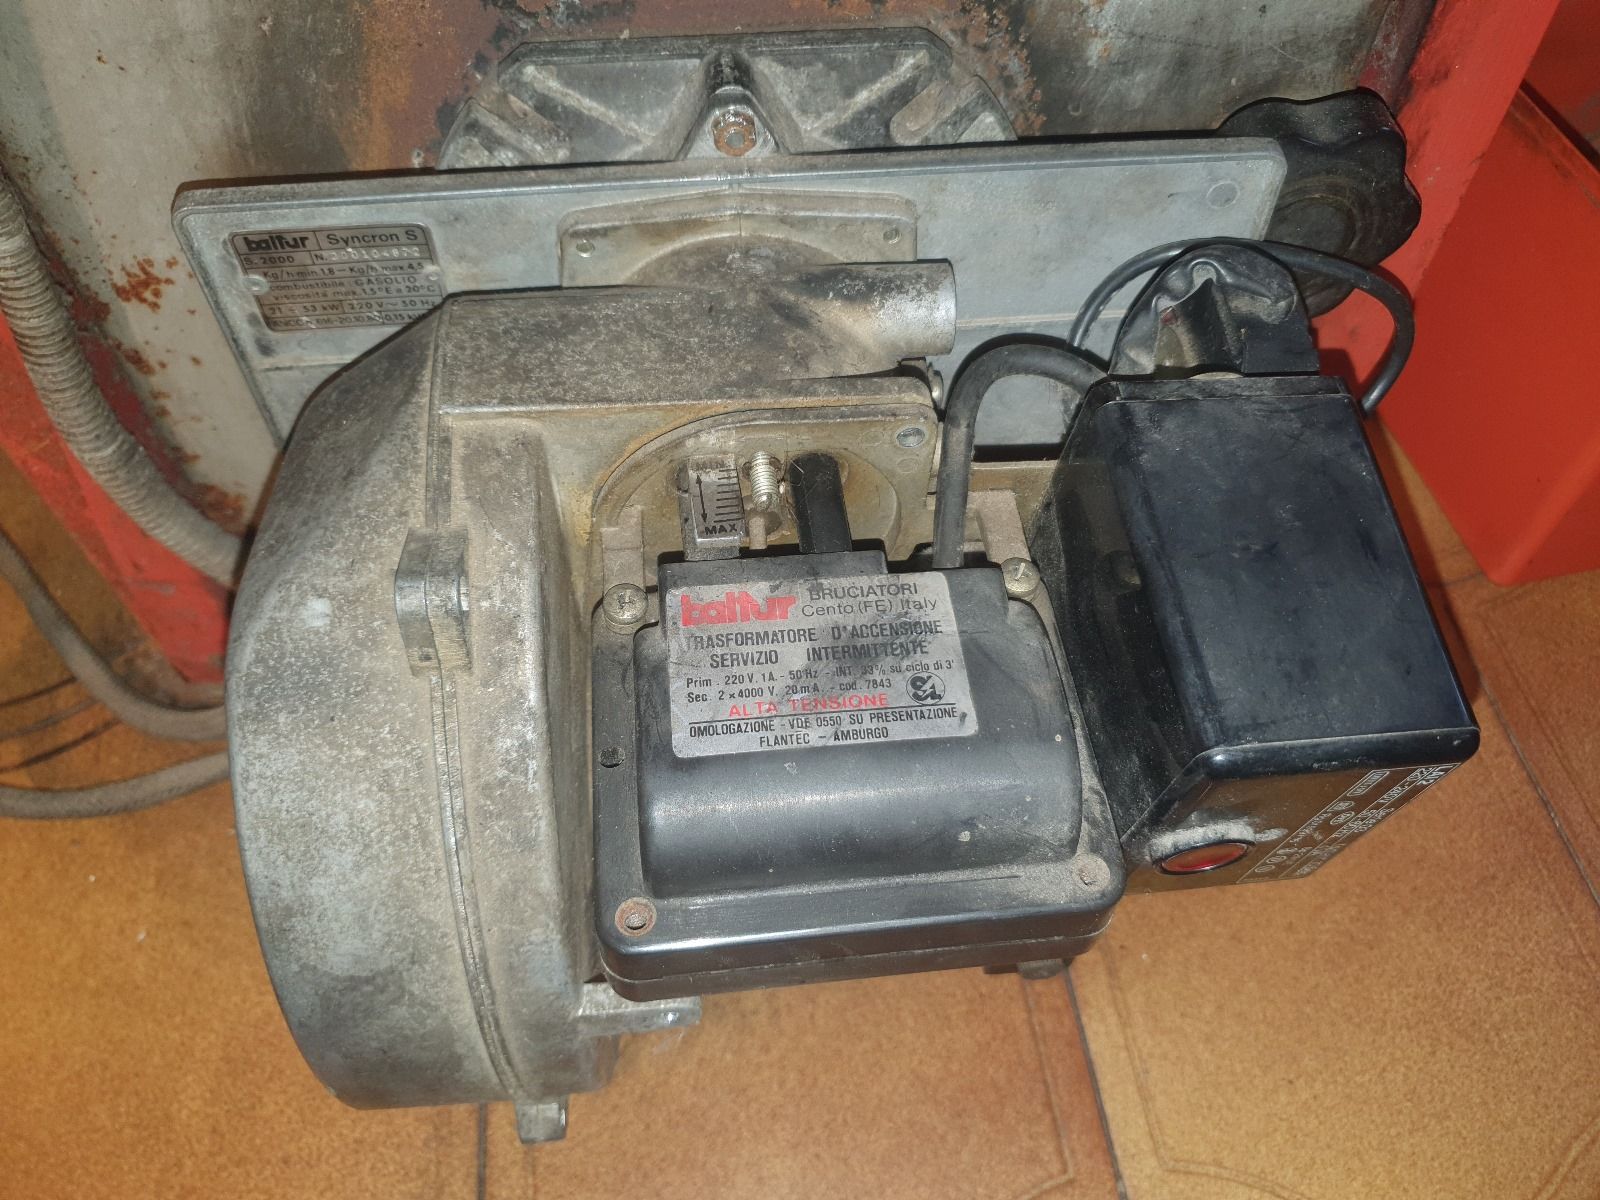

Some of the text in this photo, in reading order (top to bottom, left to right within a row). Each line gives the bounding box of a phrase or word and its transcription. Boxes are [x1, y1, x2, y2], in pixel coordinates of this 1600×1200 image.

[243, 235, 309, 251] baltur
[326, 230, 418, 246] Syncron S
[260, 255, 294, 264] 2000
[314, 253, 327, 261] N.
[355, 276, 417, 286] GASOLIO
[347, 302, 373, 310] 220
[704, 523, 738, 536] MAX
[810, 582, 918, 601] BRUCIATORI
[681, 591, 798, 628] baltur
[801, 597, 937, 617] Cento (FE) Italy
[831, 620, 942, 640] D'ACCENSIONE
[710, 640, 928, 668] SERVIZIO INTERMITTENTE
[725, 675, 744, 685] 220
[789, 670, 804, 680] 50
[805, 669, 818, 678] Hz
[906, 660, 929, 672] ciclo
[933, 660, 942, 670] di
[718, 691, 724, 700] 2
[738, 687, 763, 698] 4000
[867, 679, 892, 689] 7843
[729, 693, 889, 717] ALTA TENSIONE
[690, 720, 775, 738] OMOLOGAZIONE
[790, 717, 810, 729] VDE
[816, 716, 841, 726] 0550
[850, 714, 863, 724] SU
[870, 707, 957, 723] PRESENTAZIONE
[760, 733, 810, 747] FLANTEC
[834, 727, 889, 741] AMBURGO
